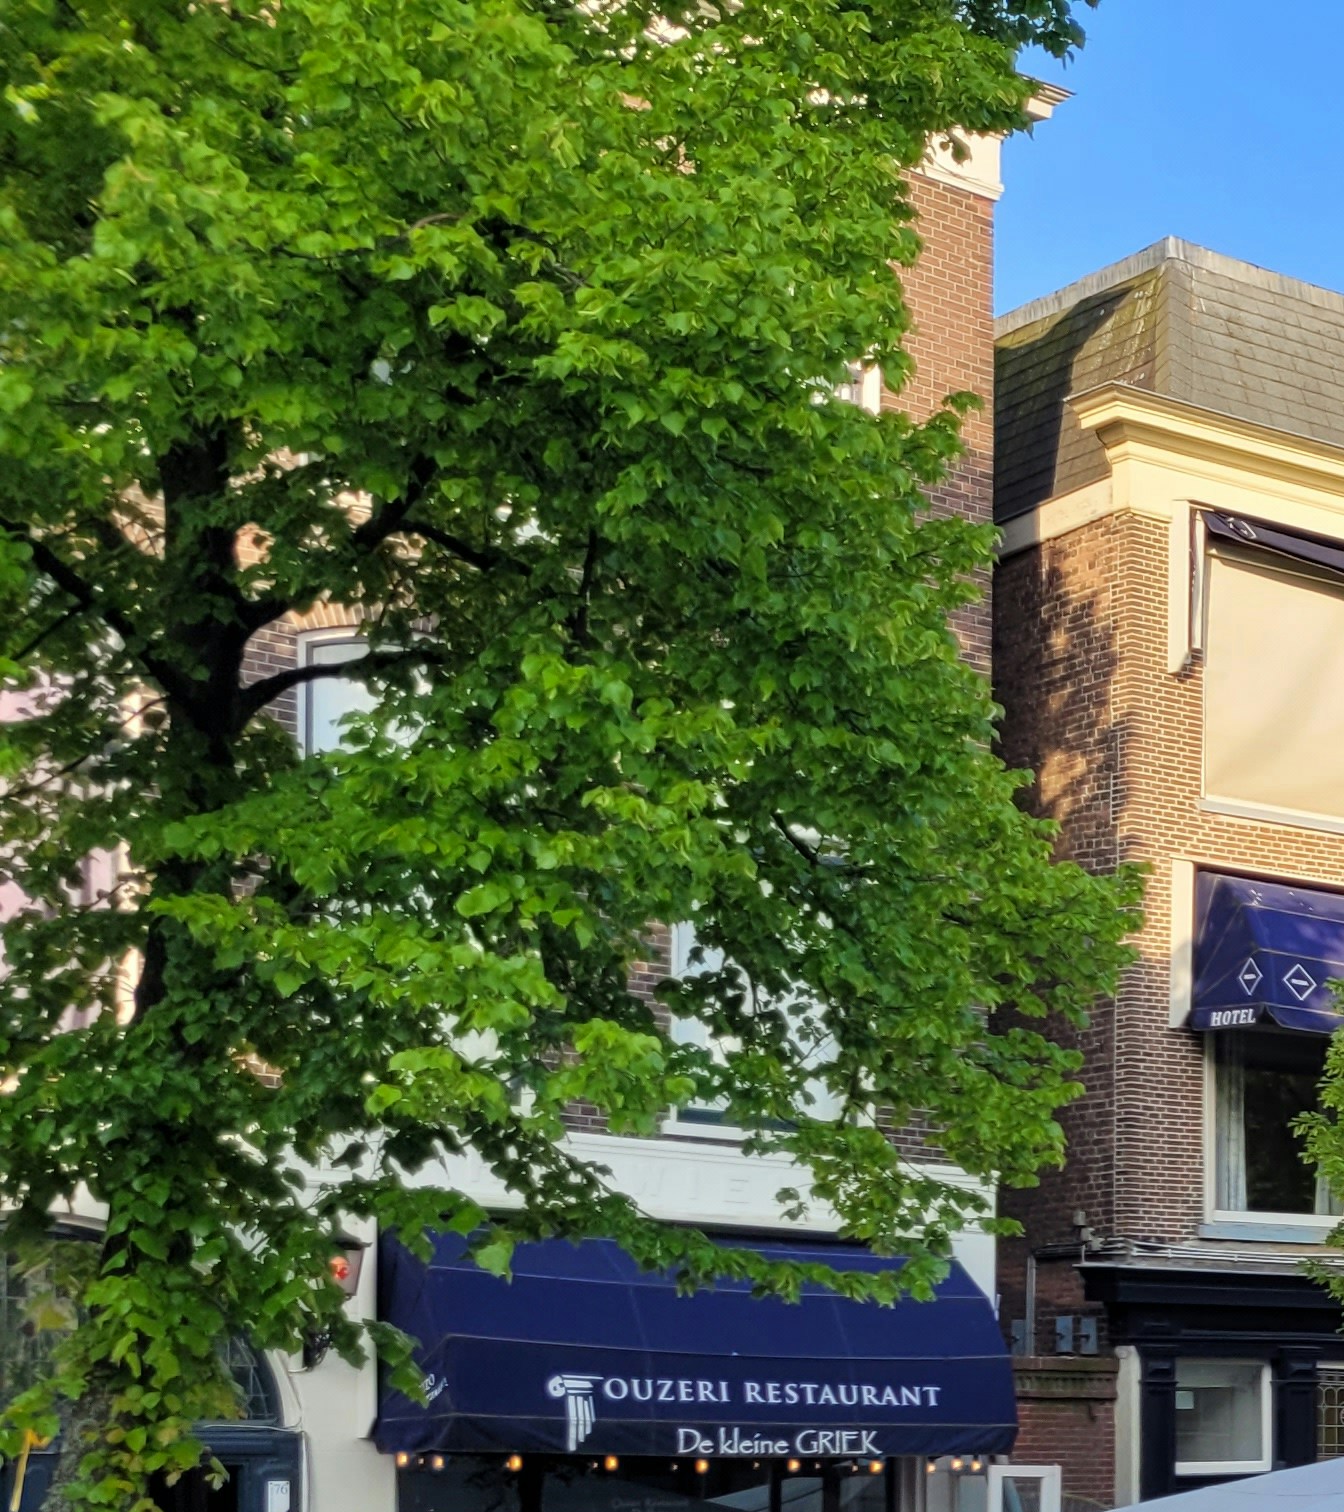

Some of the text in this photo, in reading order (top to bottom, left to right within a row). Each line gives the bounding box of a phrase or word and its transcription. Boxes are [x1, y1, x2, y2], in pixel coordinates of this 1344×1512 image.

[1209, 1008, 1256, 1027] HOTEL
[603, 1377, 941, 1407] OUZERI RESTAURANT
[677, 1426, 883, 1455] De kleine GRIEK
